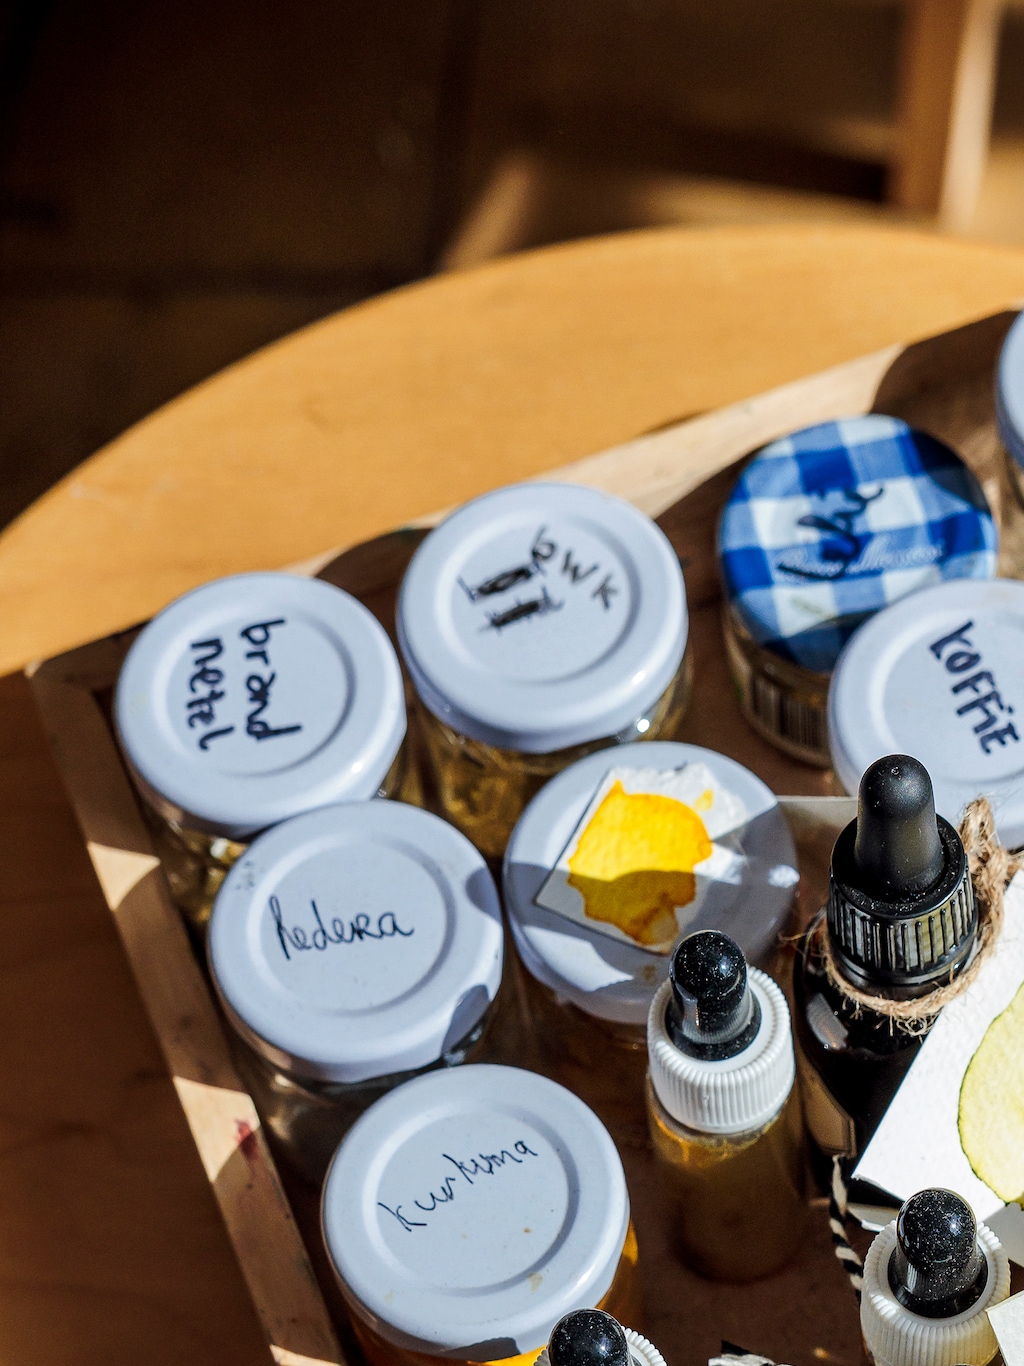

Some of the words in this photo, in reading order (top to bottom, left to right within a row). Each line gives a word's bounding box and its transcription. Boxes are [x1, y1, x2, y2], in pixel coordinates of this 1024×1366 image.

[186, 638, 235, 752] netel
[240, 618, 302, 744] brand
[377, 1140, 539, 1232] kurkuma
